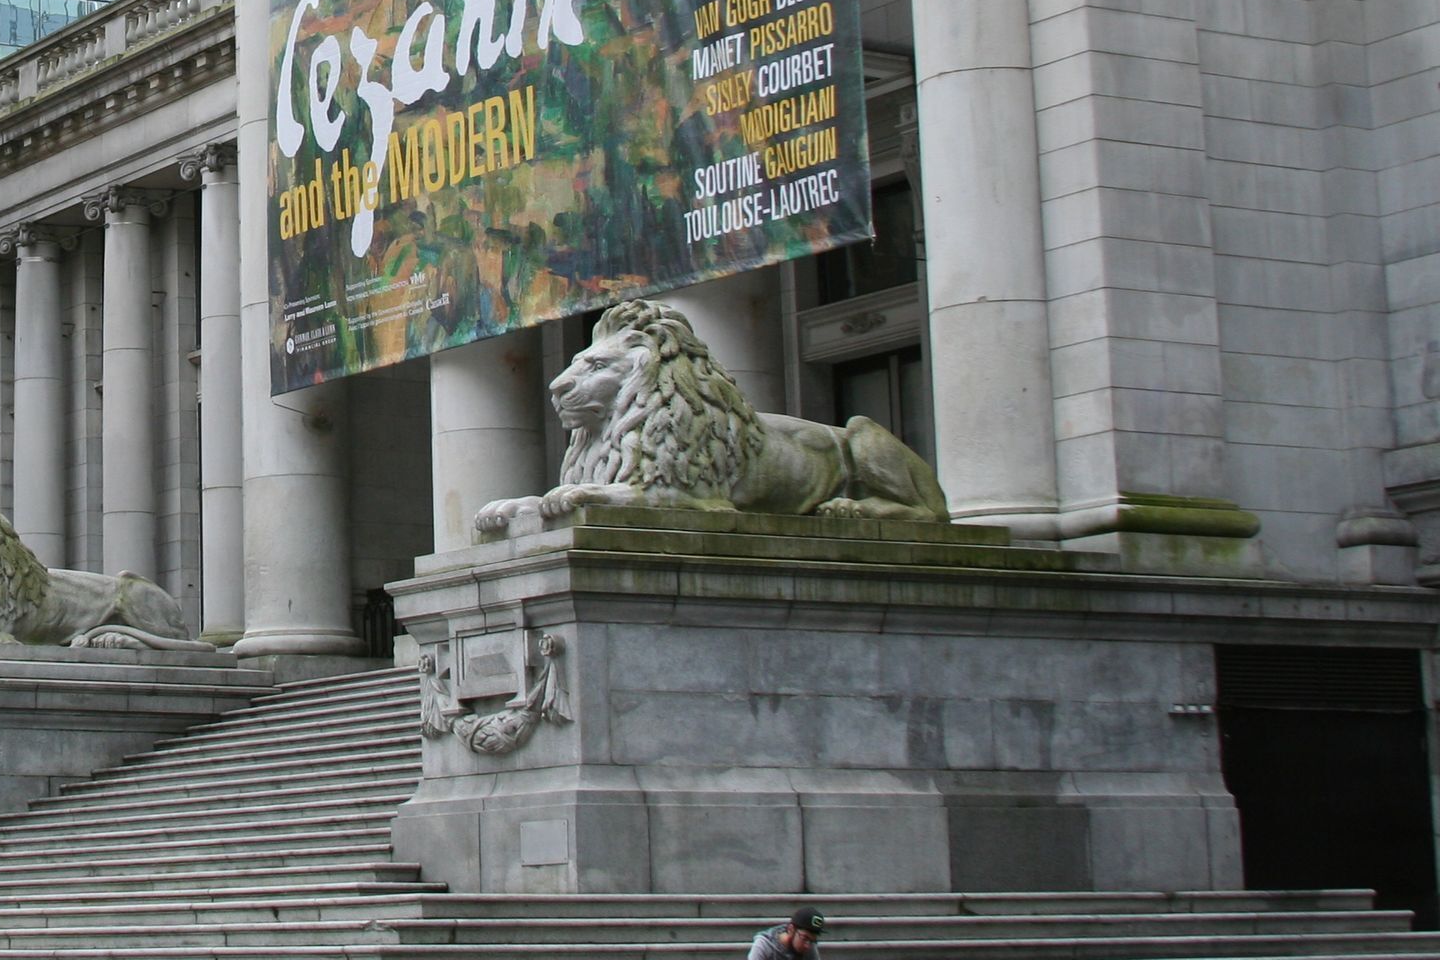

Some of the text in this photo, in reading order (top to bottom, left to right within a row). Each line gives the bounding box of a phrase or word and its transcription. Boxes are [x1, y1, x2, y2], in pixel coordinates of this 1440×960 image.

[692, 1, 835, 81] MANET PISSARRO
[694, 0, 721, 40] VAN
[706, 43, 835, 117] SISLEY COURBET
[740, 84, 836, 145] MODIGLIANI
[279, 85, 535, 241] and the MODERN
[694, 126, 837, 200] SOUTINE GAUGUIN
[684, 168, 840, 244] TOULOUSE-LAUTREC
